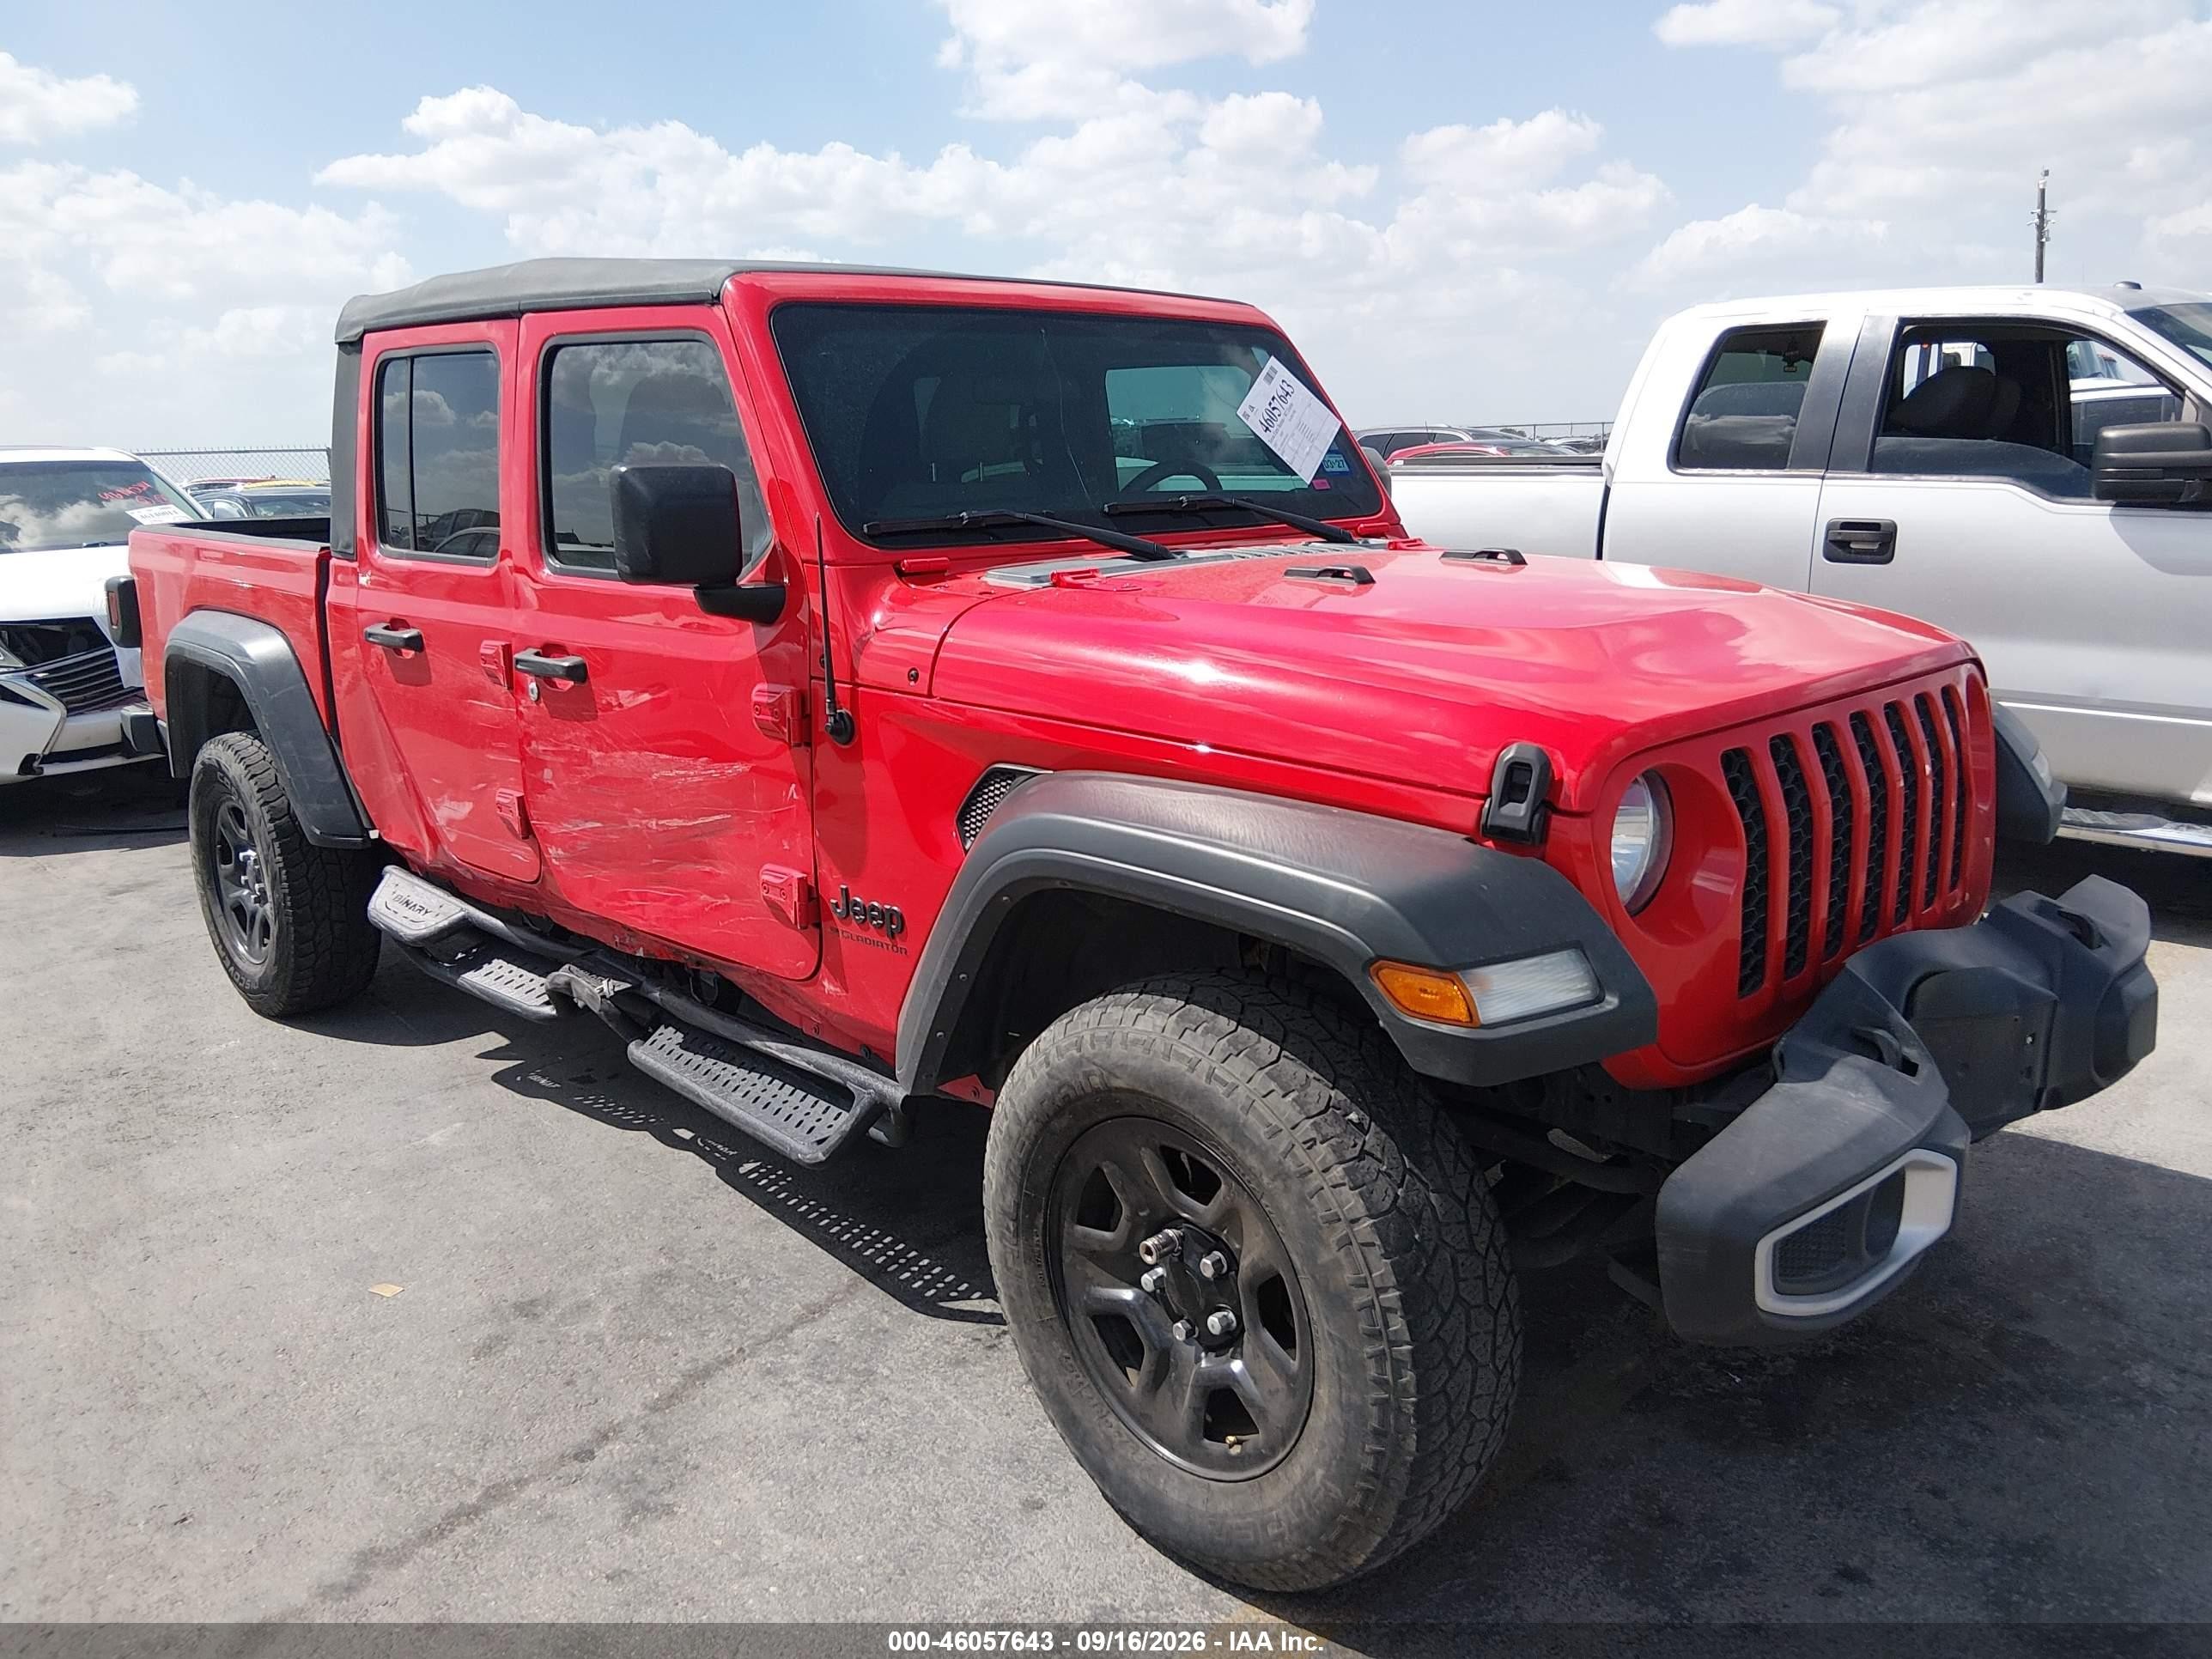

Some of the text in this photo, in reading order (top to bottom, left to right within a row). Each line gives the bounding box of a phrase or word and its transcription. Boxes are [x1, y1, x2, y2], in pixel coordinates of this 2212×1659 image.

[1258, 379, 1295, 434] 46057643
[830, 884, 904, 939] Jeep
[841, 930, 908, 956] GLADIATOR
